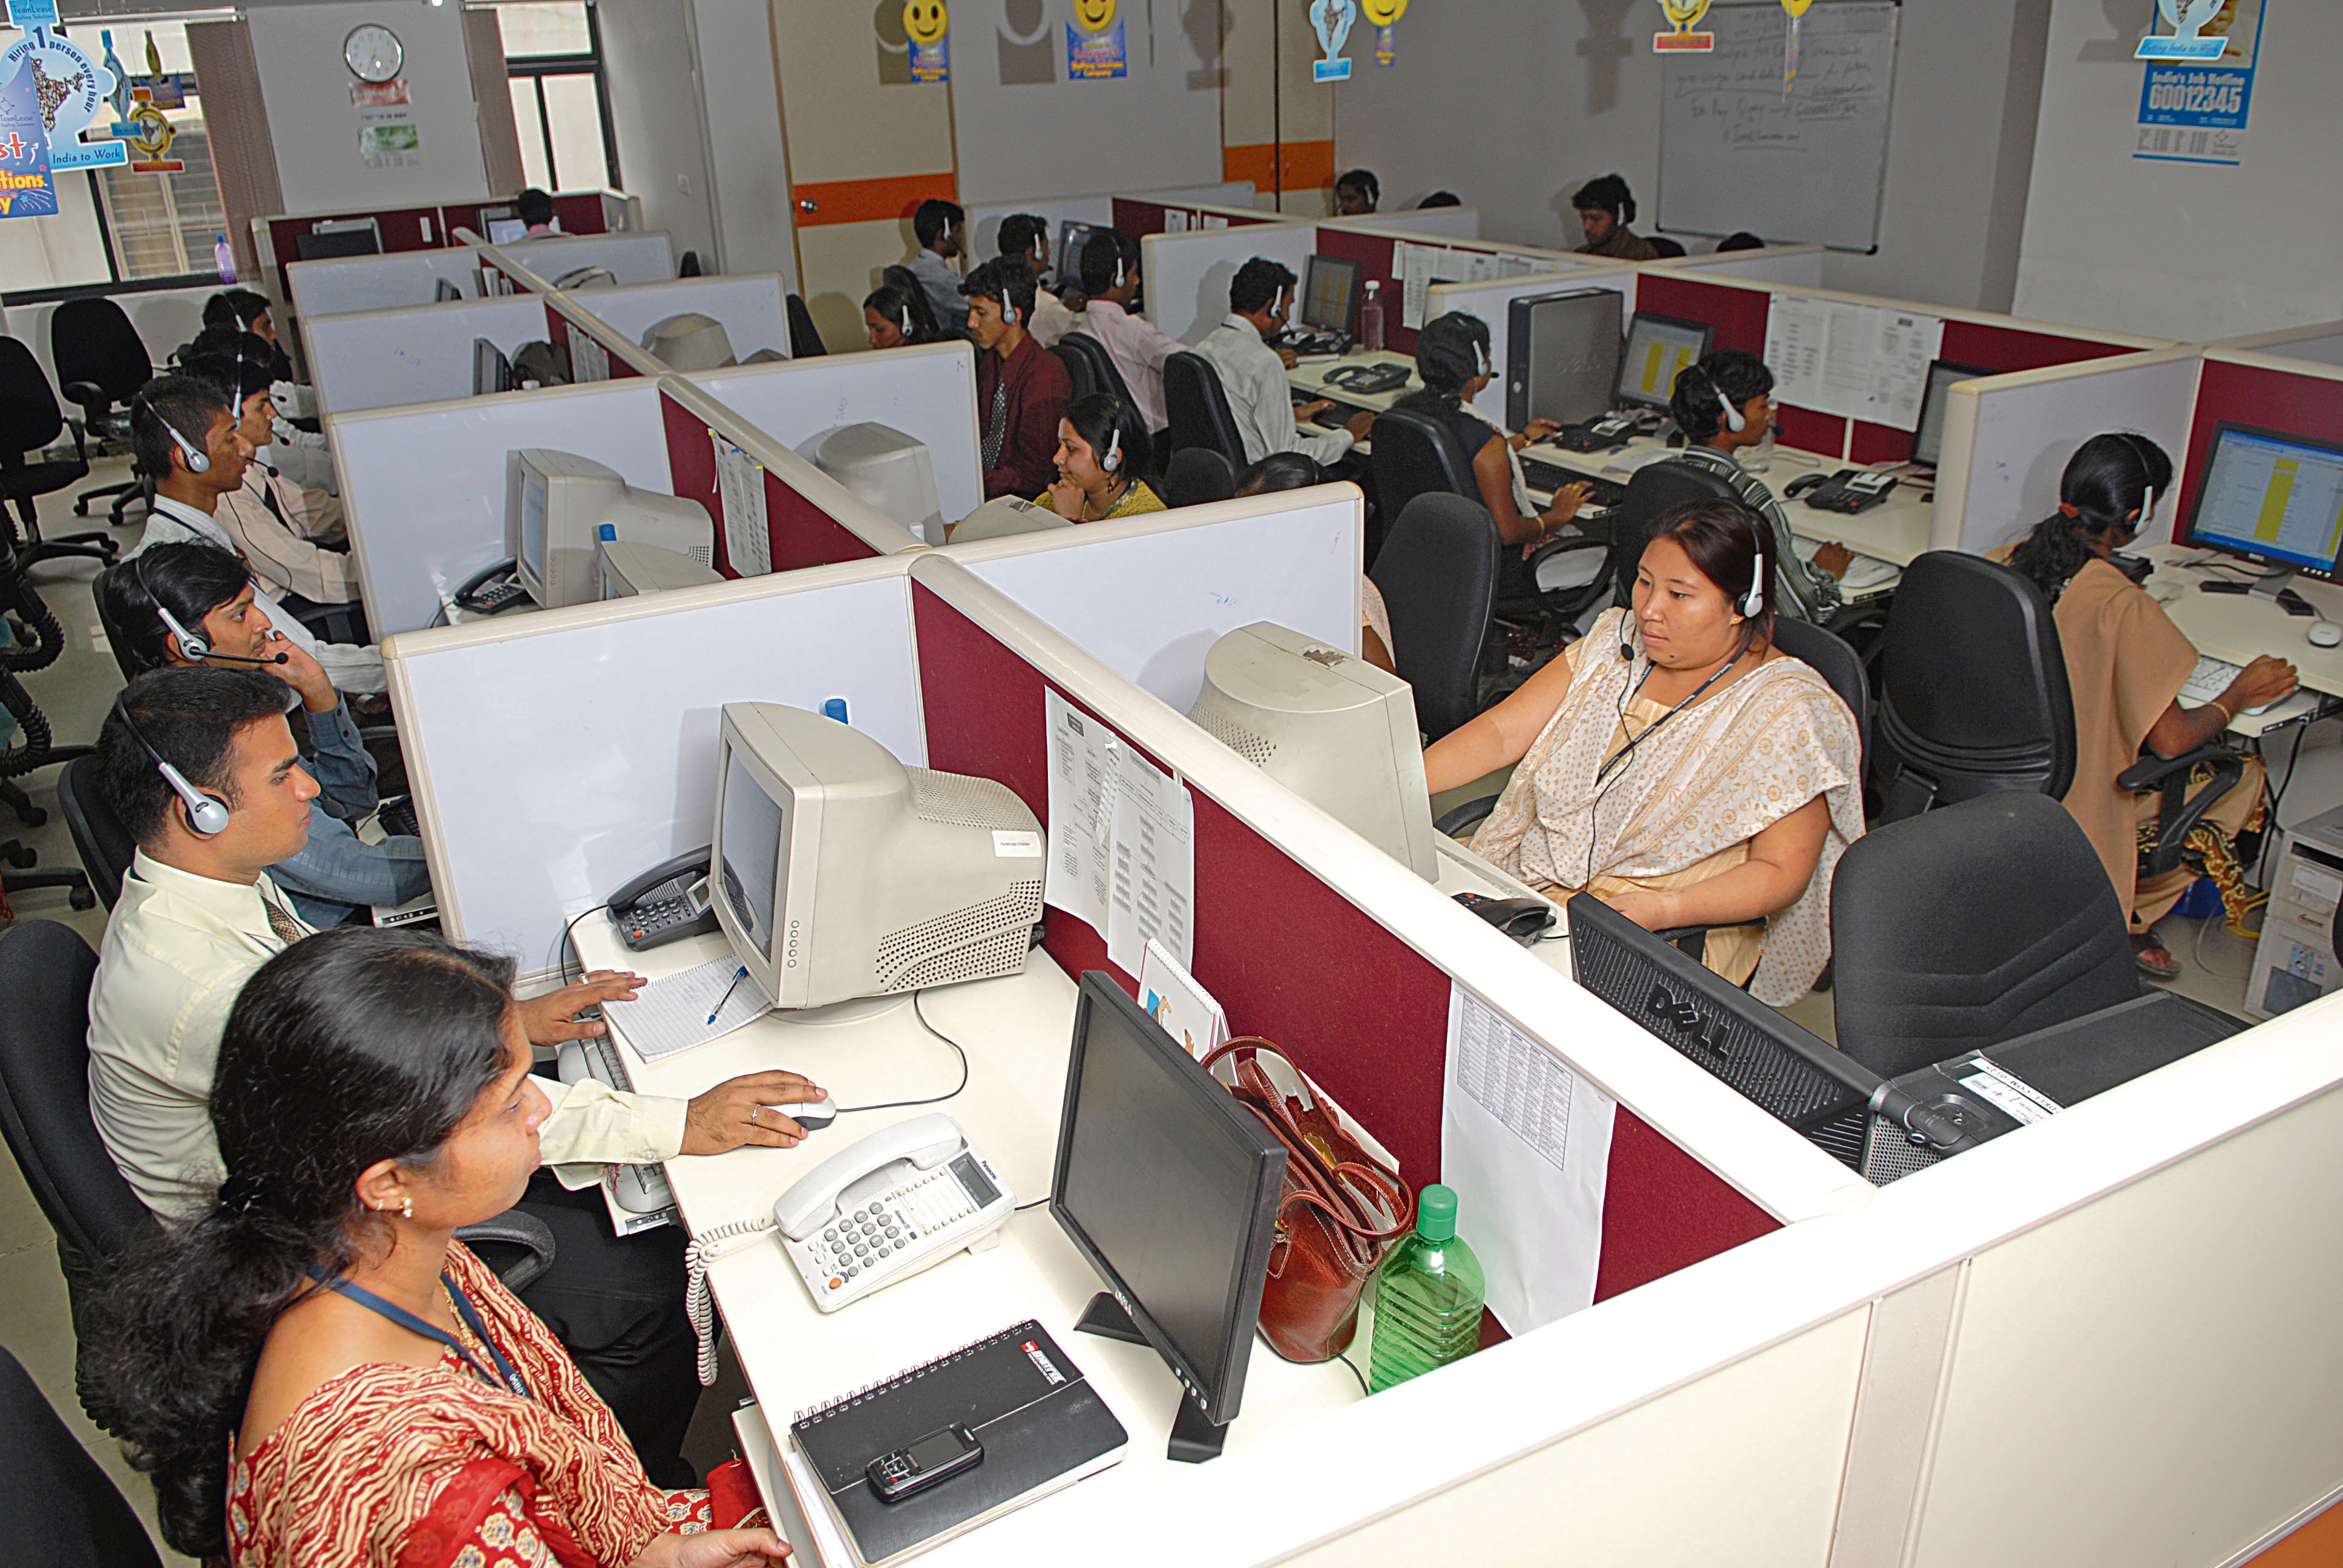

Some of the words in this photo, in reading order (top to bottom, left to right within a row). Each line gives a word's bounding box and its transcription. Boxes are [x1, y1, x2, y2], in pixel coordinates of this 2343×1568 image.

[13, 5, 53, 14] TeamLease
[33, 26, 46, 48] 1
[8, 41, 36, 62] Hiring
[50, 41, 82, 64] person
[80, 62, 96, 90] every
[84, 91, 97, 113] hour
[2149, 83, 2243, 114] 60012345
[0, 132, 26, 160] st
[53, 152, 77, 164] India
[81, 153, 91, 162] to
[94, 148, 120, 160] Work
[0, 170, 45, 190] tions
[1647, 981, 1729, 1062] DELL
[981, 1160, 997, 1180] Panasonic
